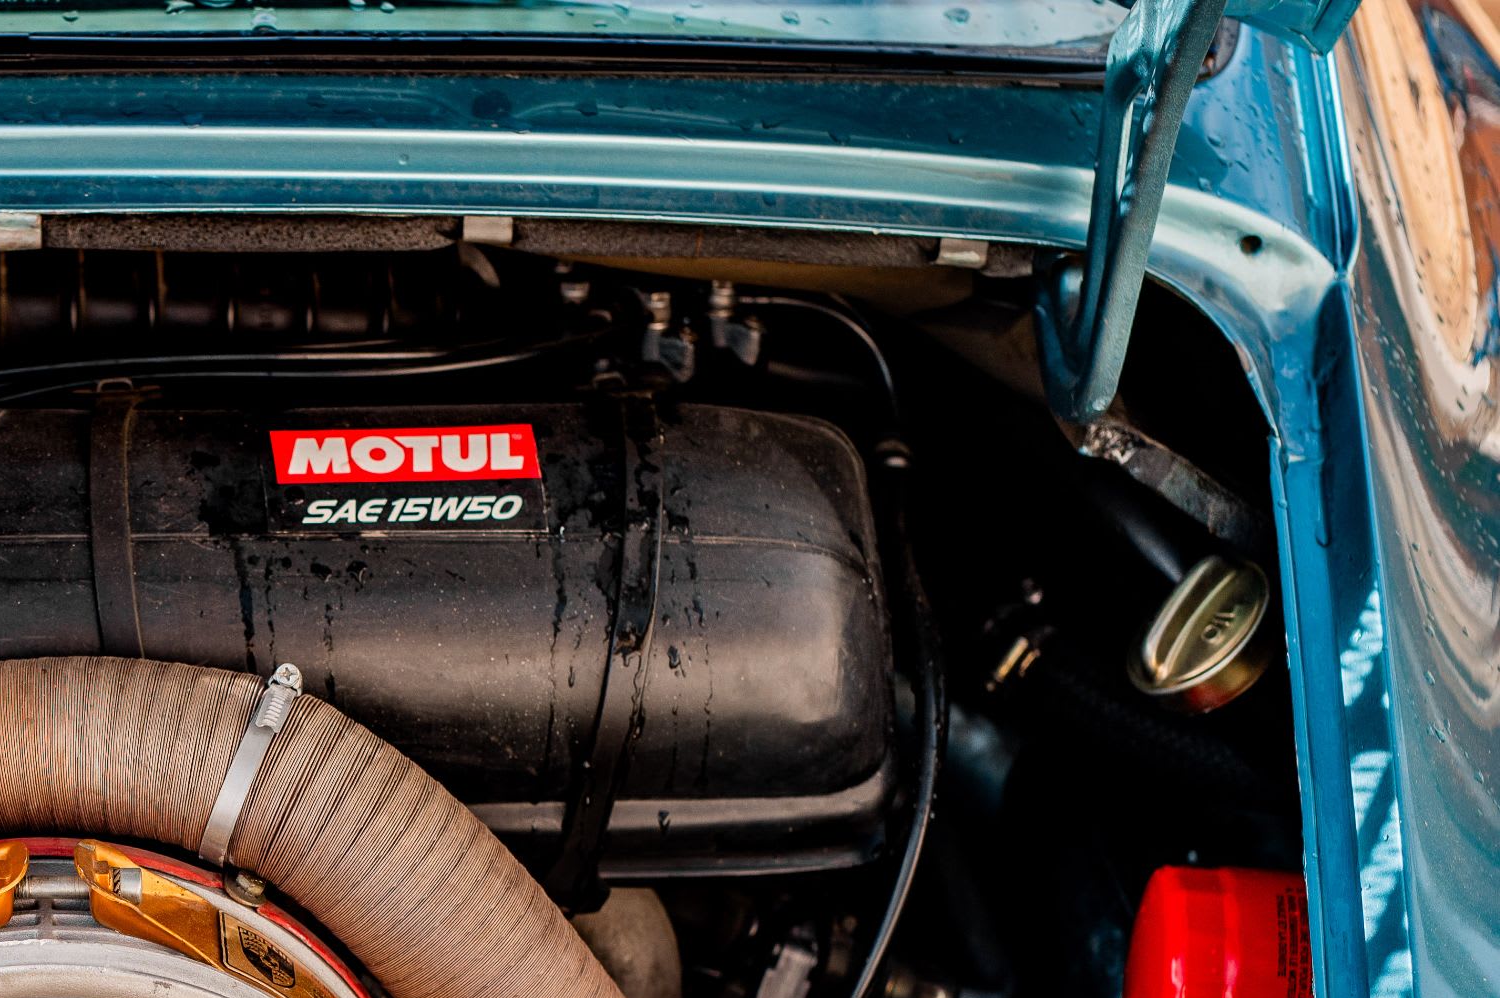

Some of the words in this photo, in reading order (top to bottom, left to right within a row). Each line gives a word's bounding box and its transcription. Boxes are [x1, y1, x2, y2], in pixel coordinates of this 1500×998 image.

[287, 433, 525, 475] MOTUL
[302, 497, 387, 524] SAE
[387, 495, 524, 522] 15W50
